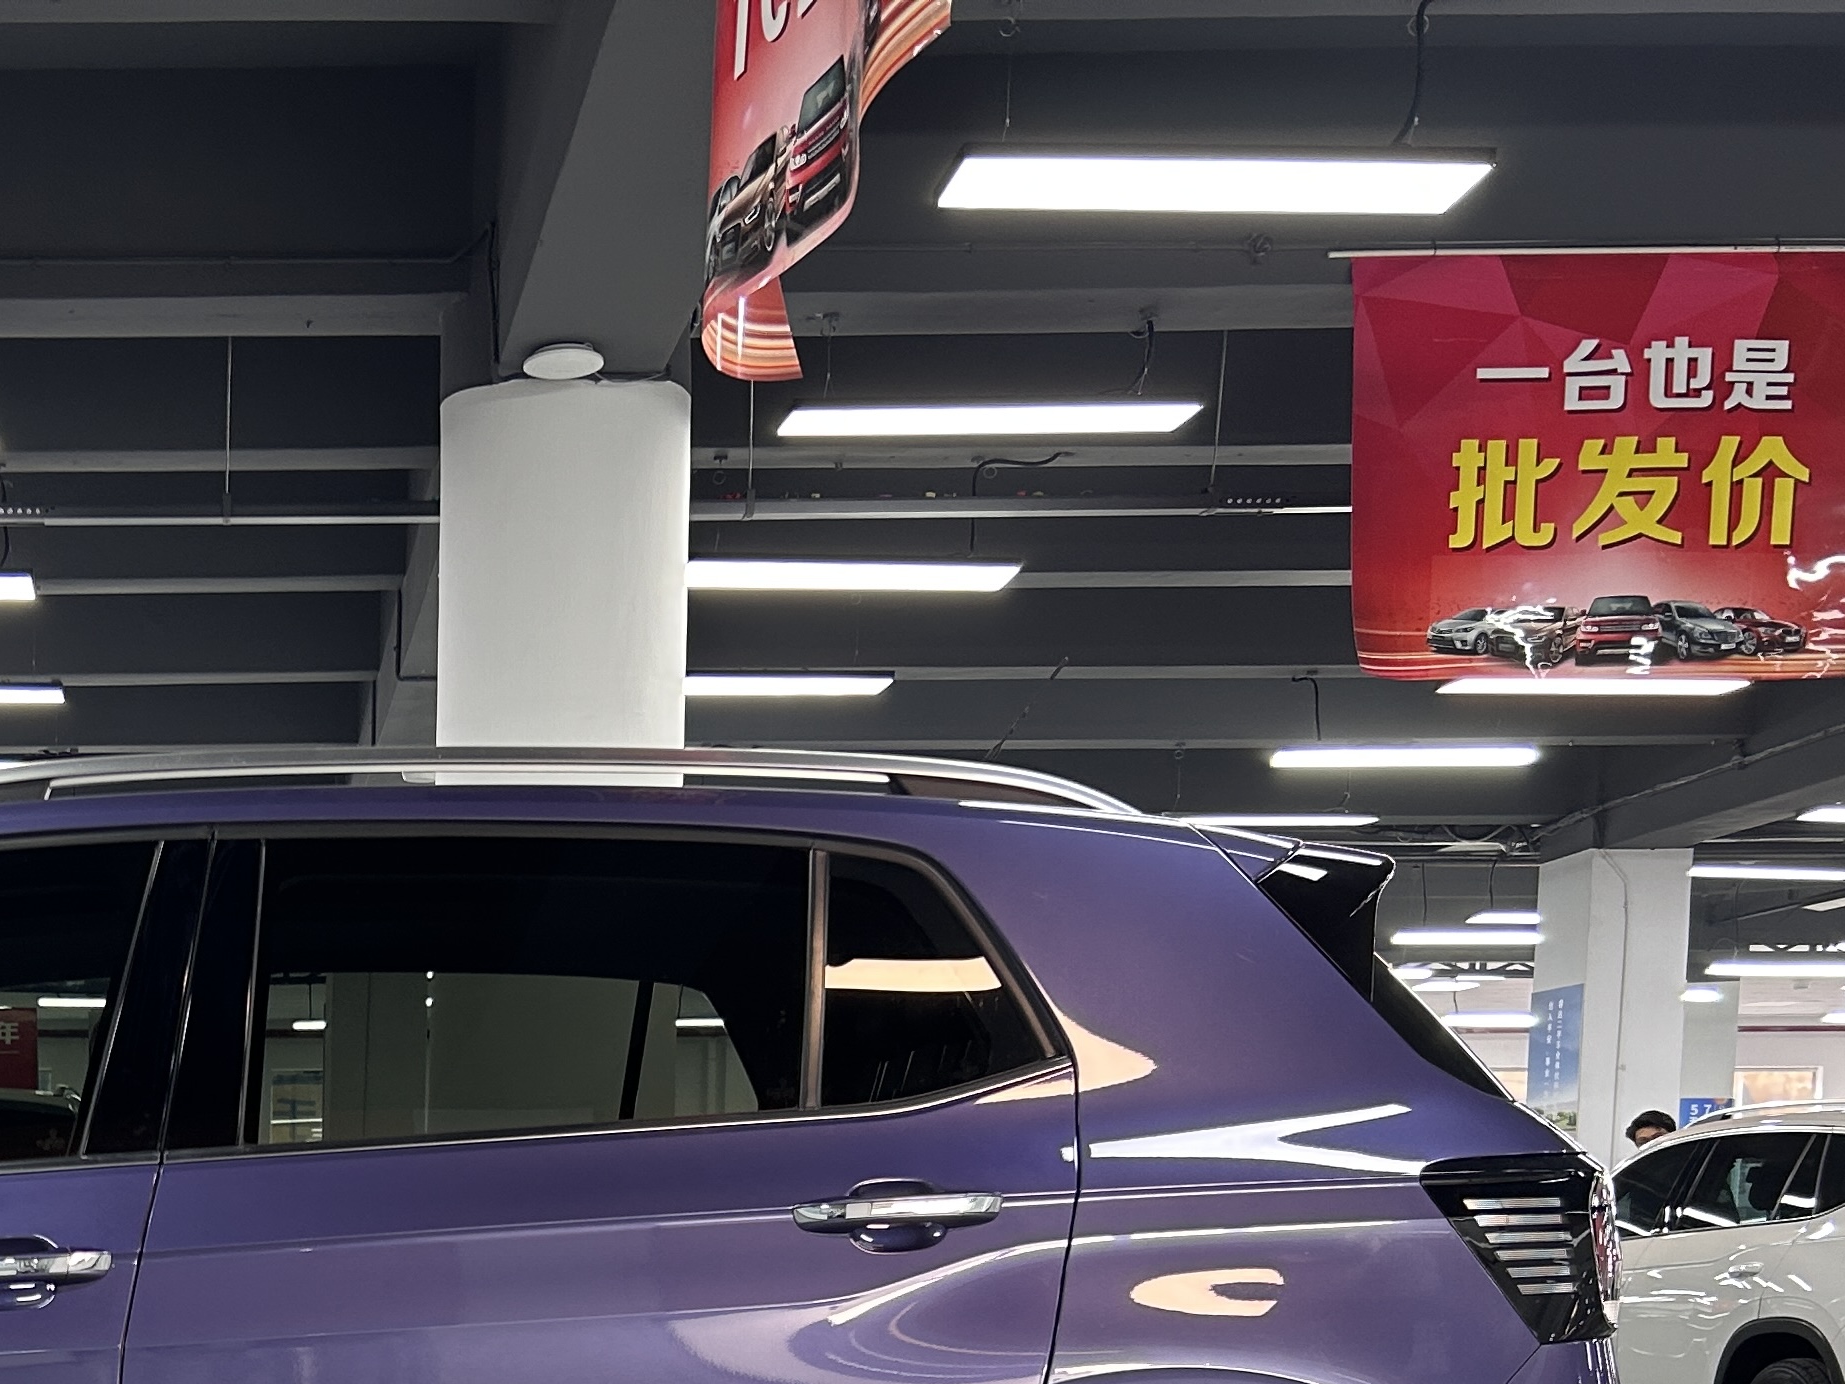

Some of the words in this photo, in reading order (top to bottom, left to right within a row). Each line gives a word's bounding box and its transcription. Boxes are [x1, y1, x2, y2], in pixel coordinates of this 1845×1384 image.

[1476, 336, 1796, 412] 一台也是
[1448, 435, 1811, 550] 批发价
